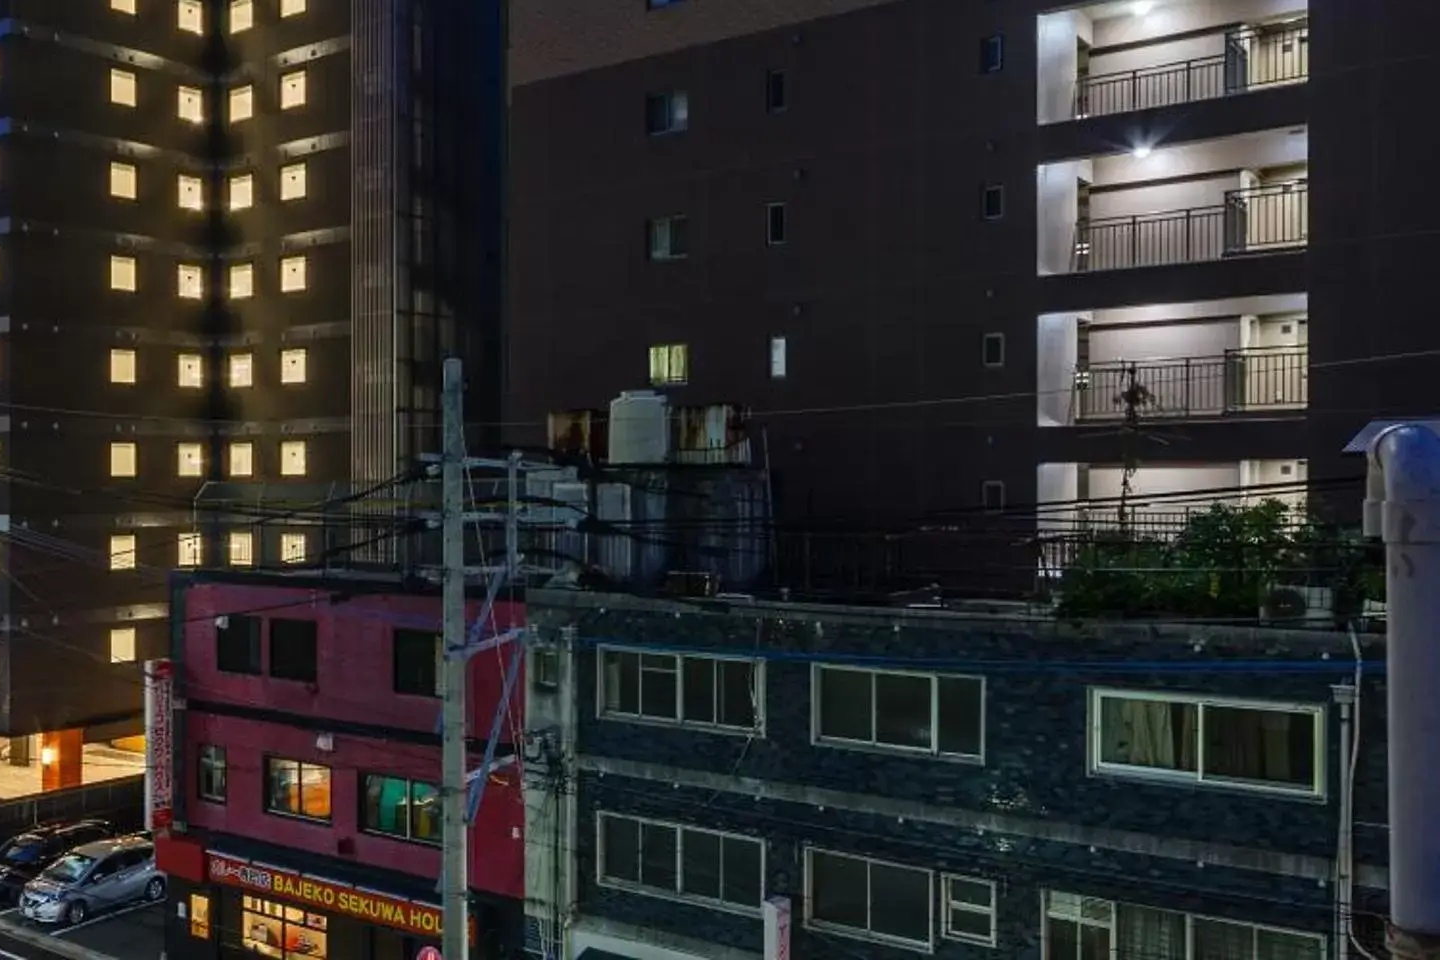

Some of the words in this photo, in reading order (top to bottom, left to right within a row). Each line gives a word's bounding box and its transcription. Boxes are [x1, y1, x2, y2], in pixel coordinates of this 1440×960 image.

[273, 875, 334, 905] BAJEKO
[338, 890, 405, 925] SEKUWA
[409, 907, 443, 935] HOU
